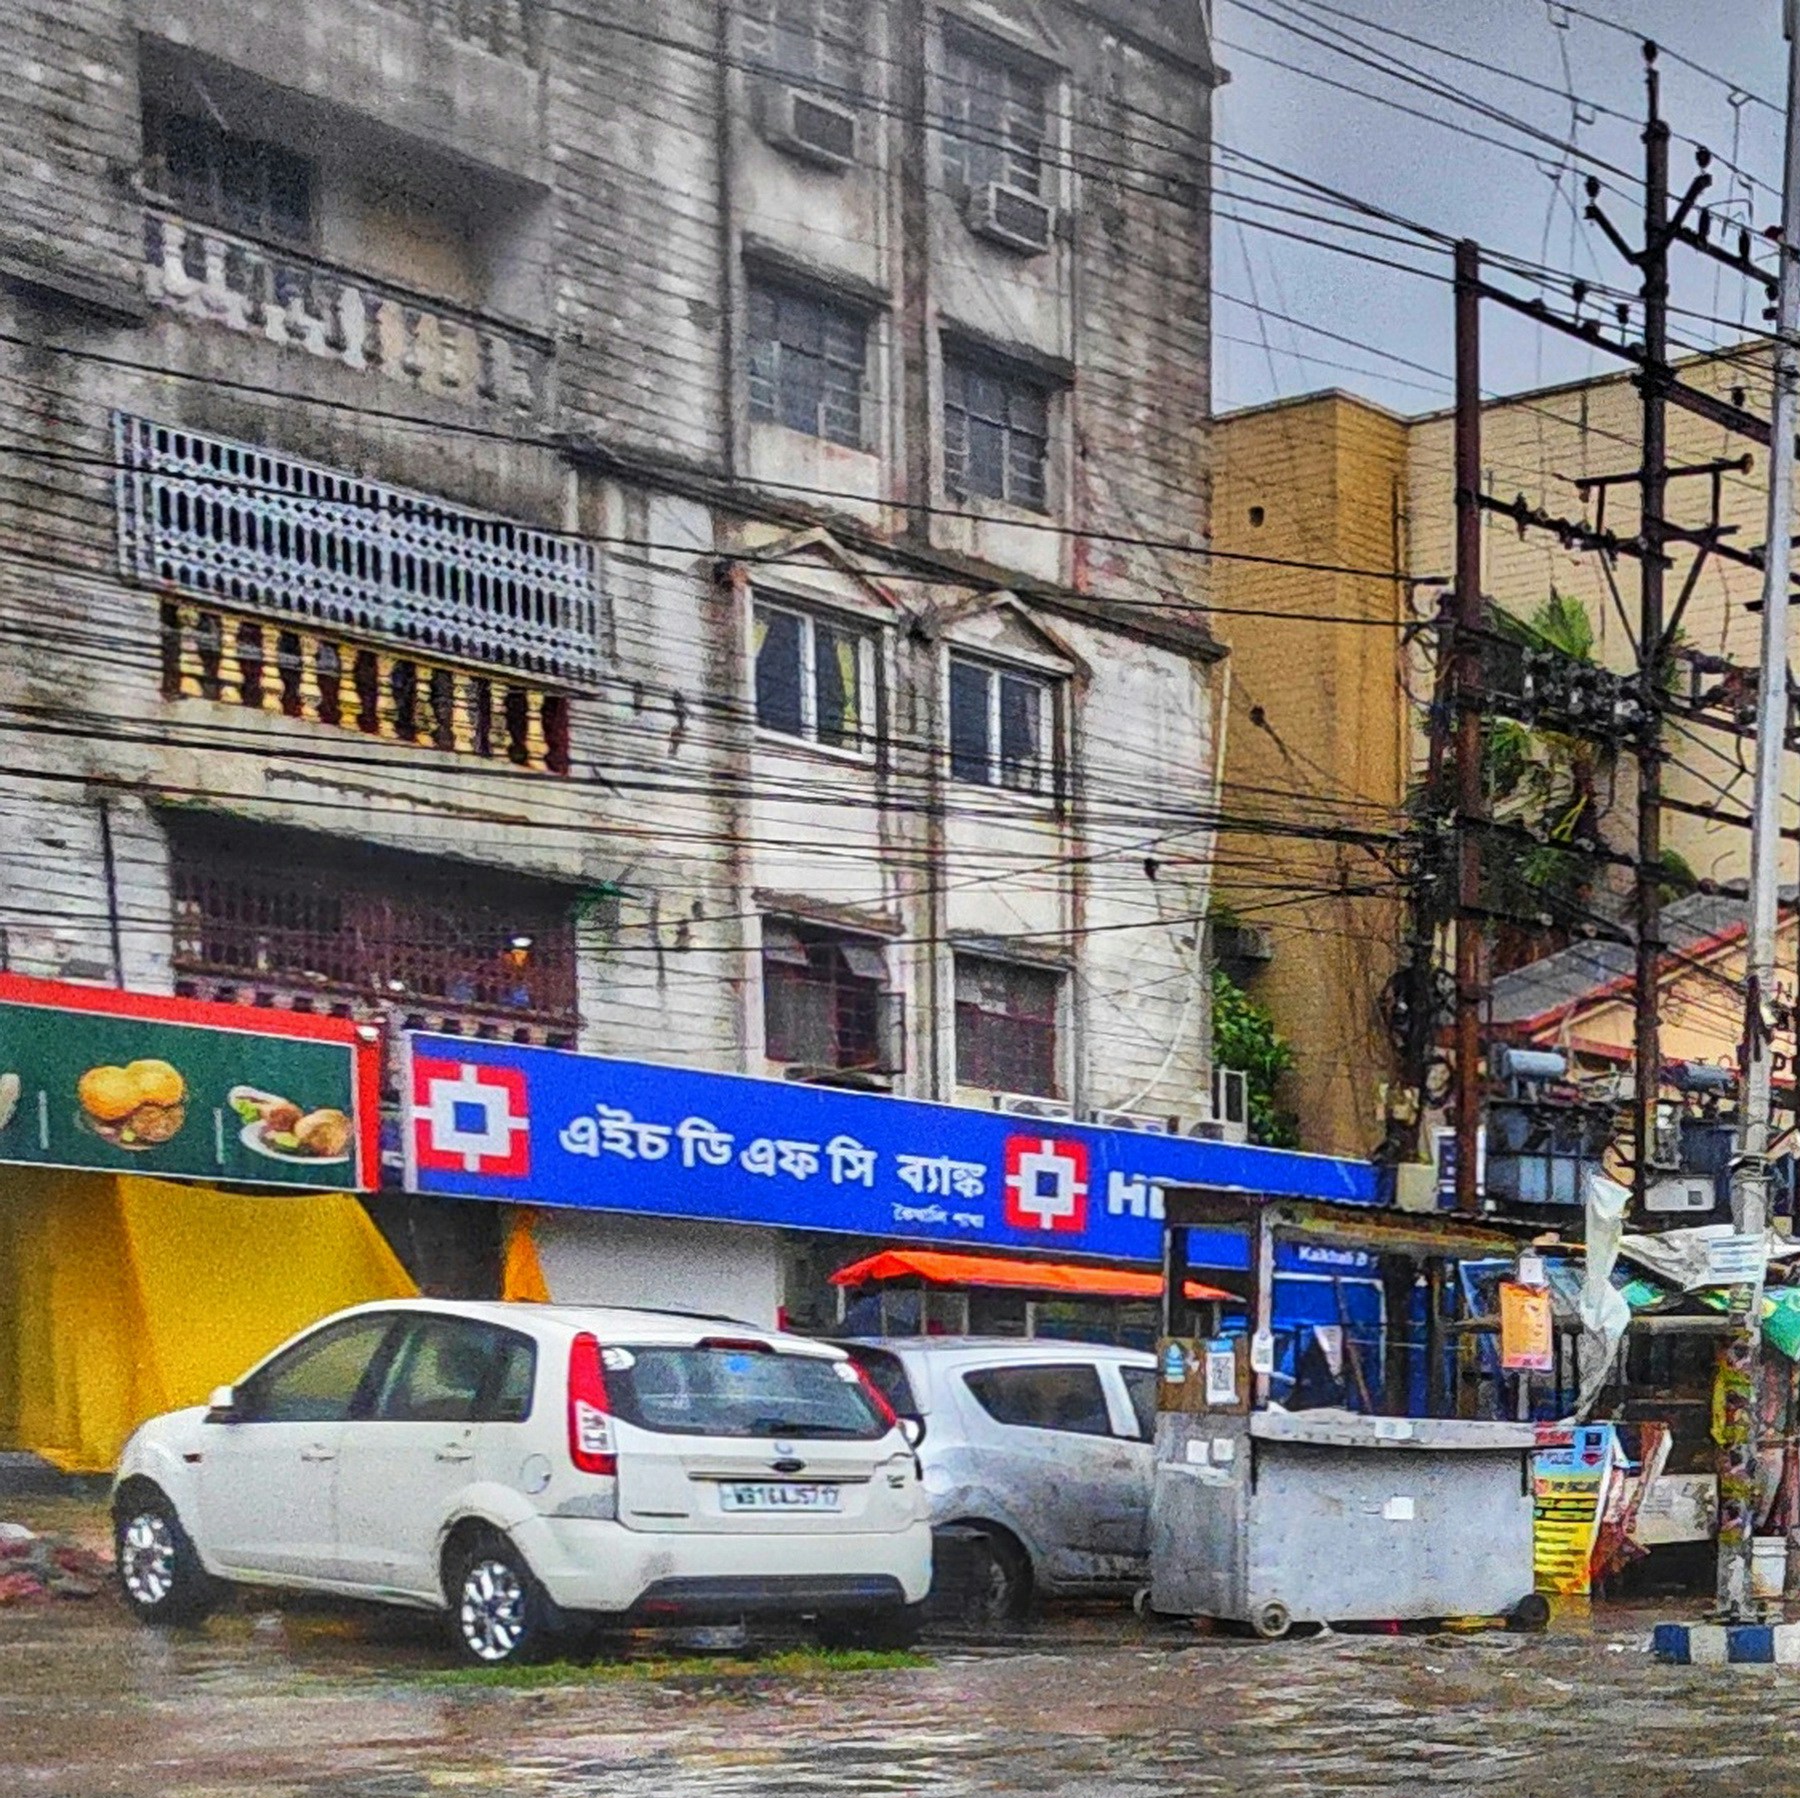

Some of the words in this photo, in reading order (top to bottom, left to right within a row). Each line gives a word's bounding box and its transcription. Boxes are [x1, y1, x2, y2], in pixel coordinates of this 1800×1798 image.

[559, 1103, 671, 1160] এইচ
[676, 1115, 735, 1168] ডি
[740, 1136, 820, 1181] এফ
[825, 1133, 878, 1188] সি
[895, 1153, 988, 1199] ব্যাঙ্ক
